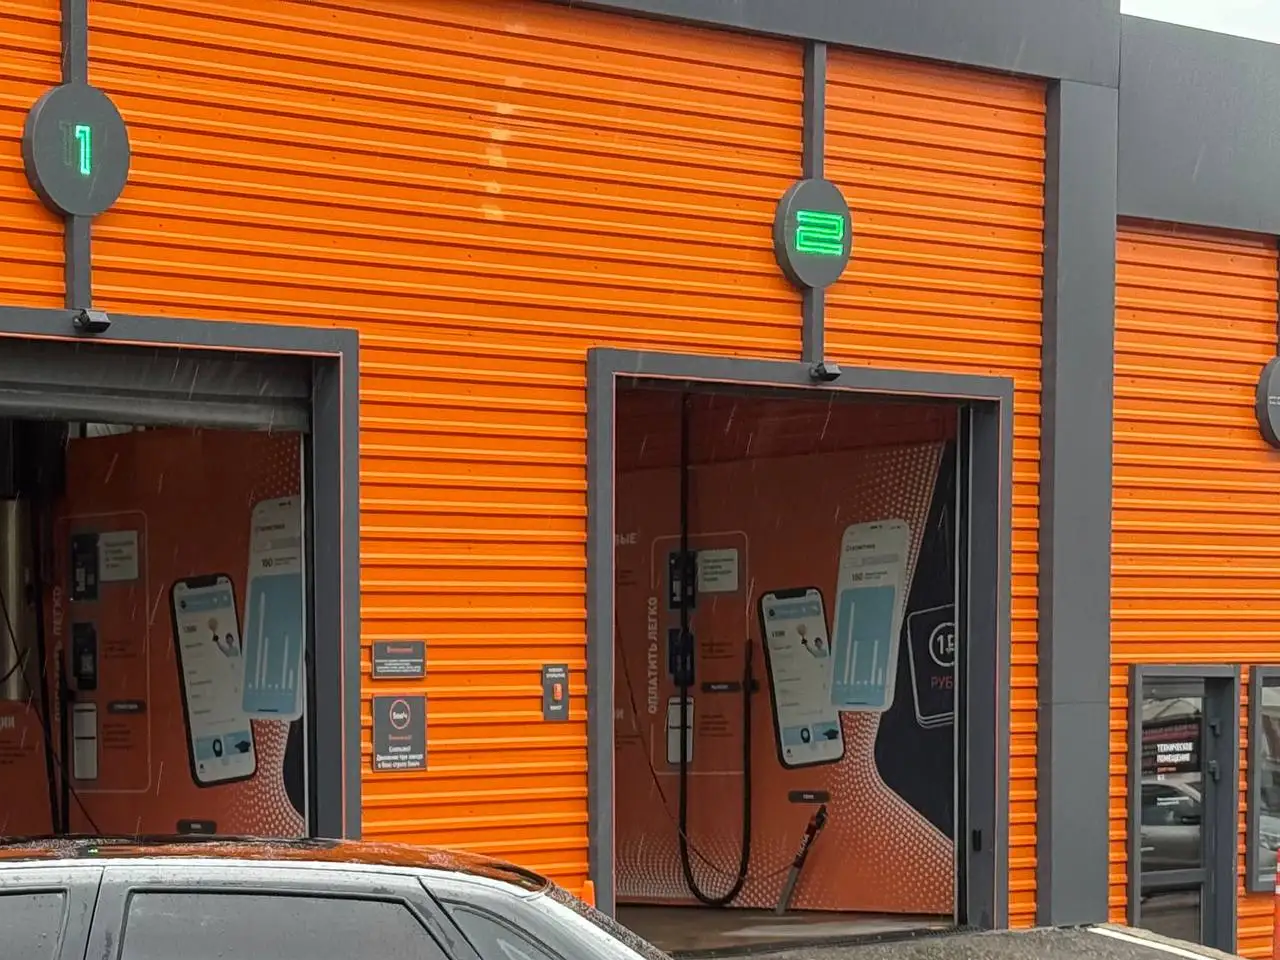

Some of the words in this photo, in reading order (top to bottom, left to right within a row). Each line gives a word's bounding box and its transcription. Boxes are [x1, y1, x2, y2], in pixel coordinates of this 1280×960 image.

[75, 125, 92, 175] 1
[796, 210, 844, 256] 2
[648, 597, 658, 641] ЛЕГКО
[647, 643, 658, 715] ОПЛАТИТЬ
